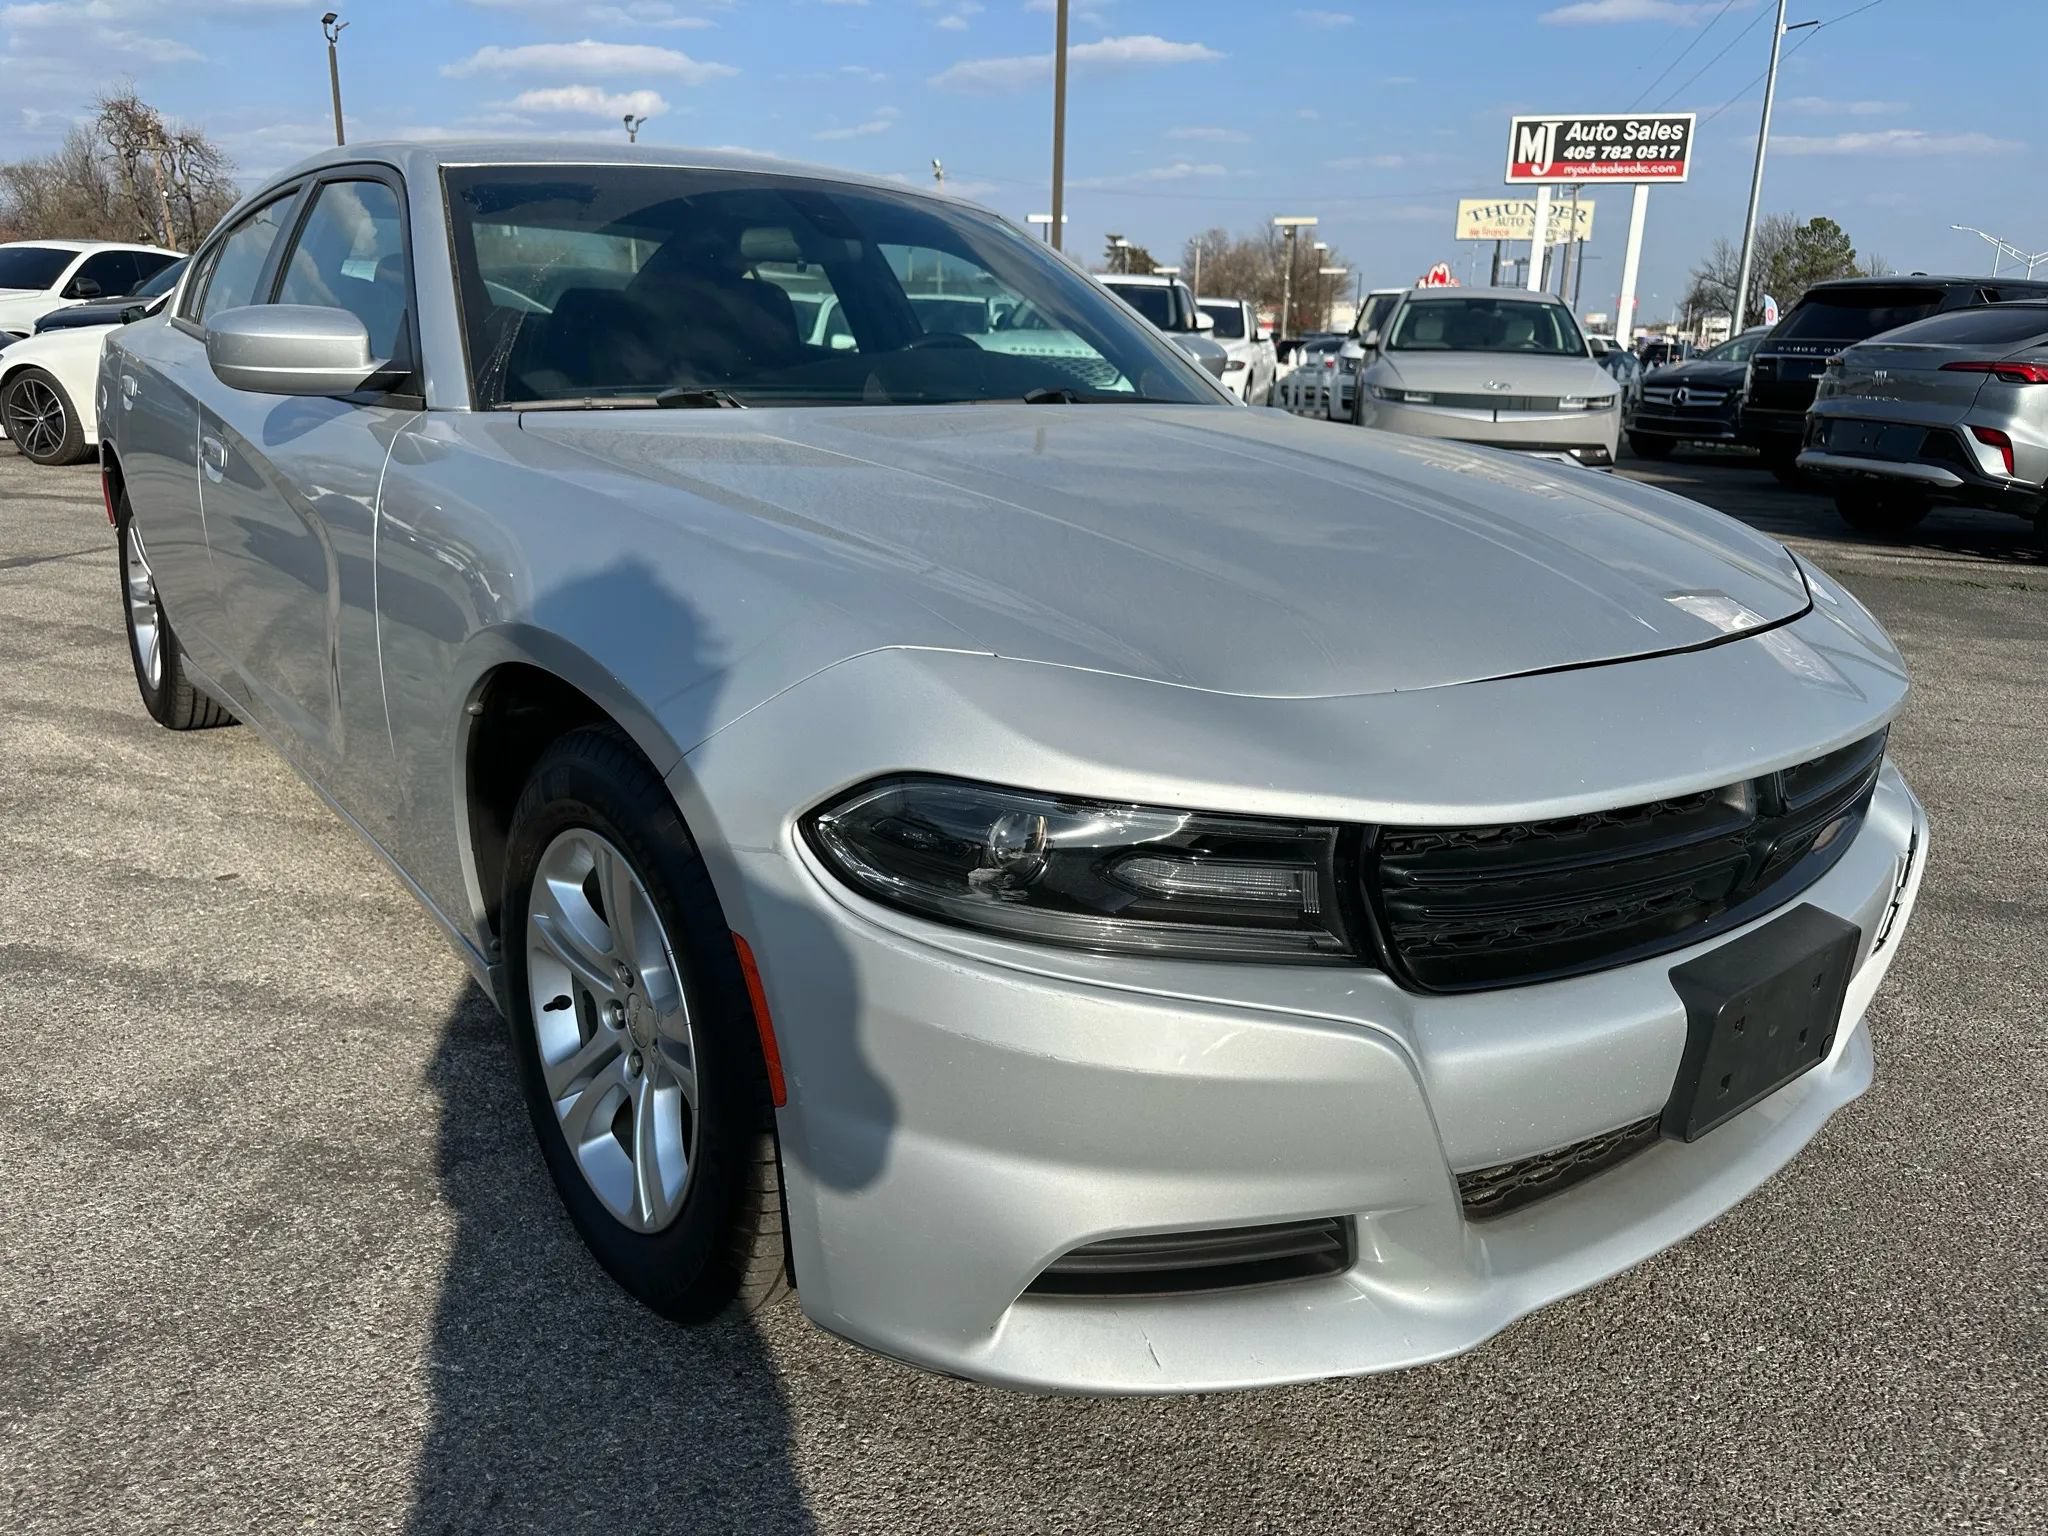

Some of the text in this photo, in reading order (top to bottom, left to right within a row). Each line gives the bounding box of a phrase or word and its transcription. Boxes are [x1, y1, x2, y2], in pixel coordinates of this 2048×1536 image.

[1565, 120, 1684, 141] Auto Sales
[1517, 122, 1563, 176] MJ
[1563, 145, 1681, 160] 405 782 0517
[1563, 162, 1677, 178] mjautosalesokc.com
[1495, 217, 1525, 227] AUTO
